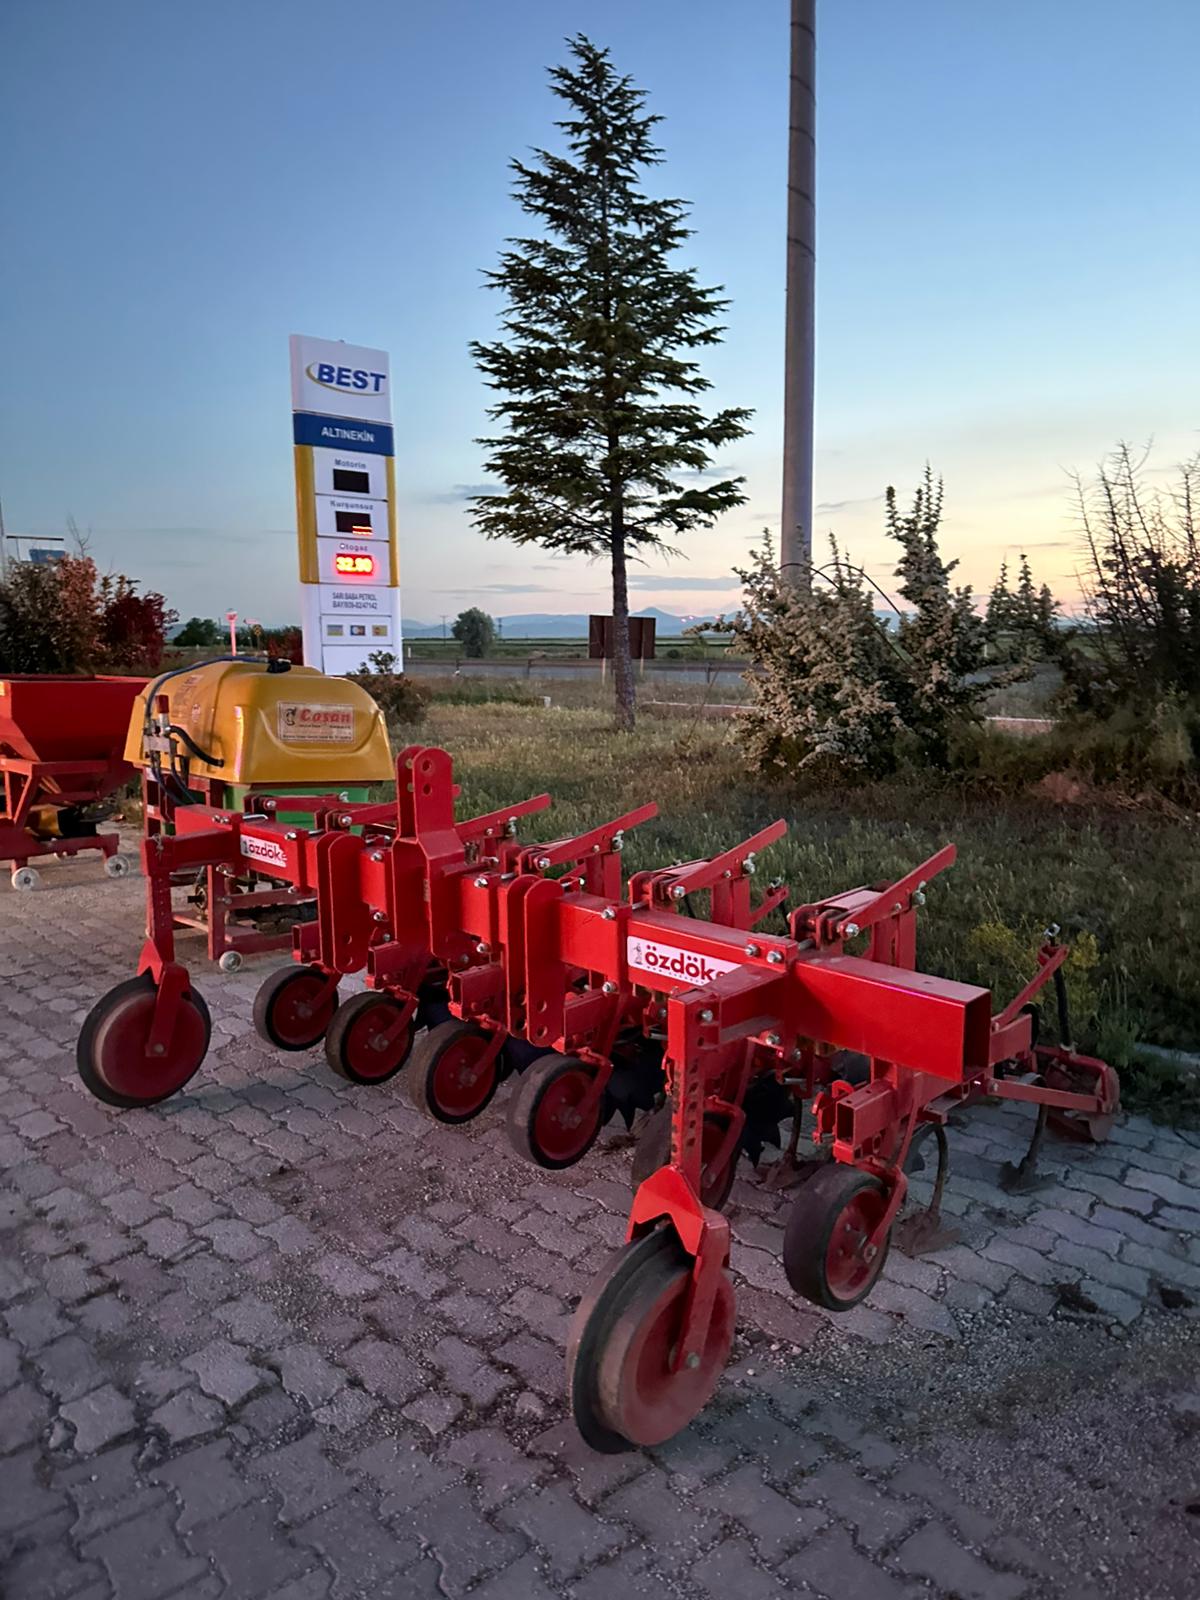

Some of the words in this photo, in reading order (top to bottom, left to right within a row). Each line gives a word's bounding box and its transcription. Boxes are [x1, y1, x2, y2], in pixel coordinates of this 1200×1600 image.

[318, 363, 386, 392] BEST
[321, 426, 374, 443] ALTINEKİN
[334, 458, 367, 469] Motorin
[340, 542, 368, 552] Otogaz
[359, 593, 377, 602] PETROL
